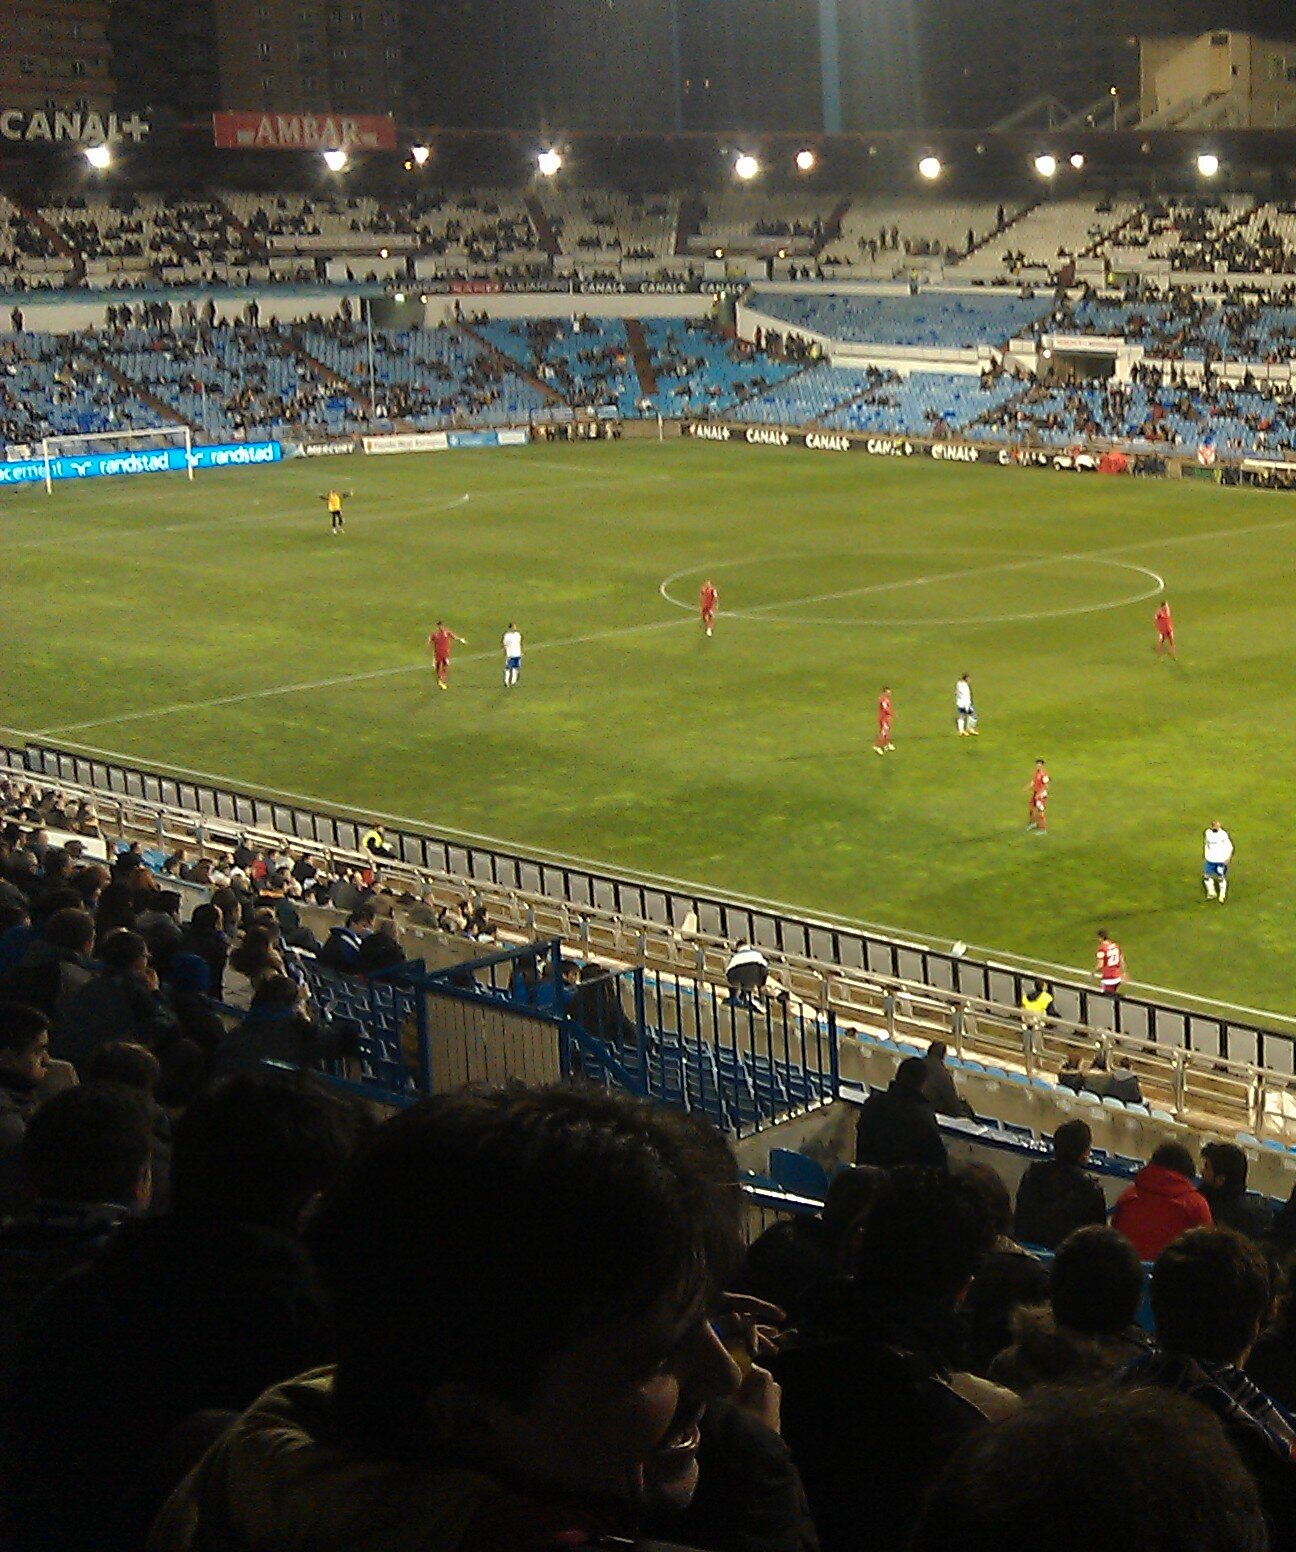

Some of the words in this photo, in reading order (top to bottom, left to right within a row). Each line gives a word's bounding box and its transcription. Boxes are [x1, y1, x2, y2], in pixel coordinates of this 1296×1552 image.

[1, 107, 150, 142] CANAL+
[255, 114, 361, 146] AMBAR
[745, 428, 790, 446] CANAL+
[805, 433, 850, 452] CANAL+
[100, 452, 169, 474] randstad
[210, 443, 274, 464] randstad
